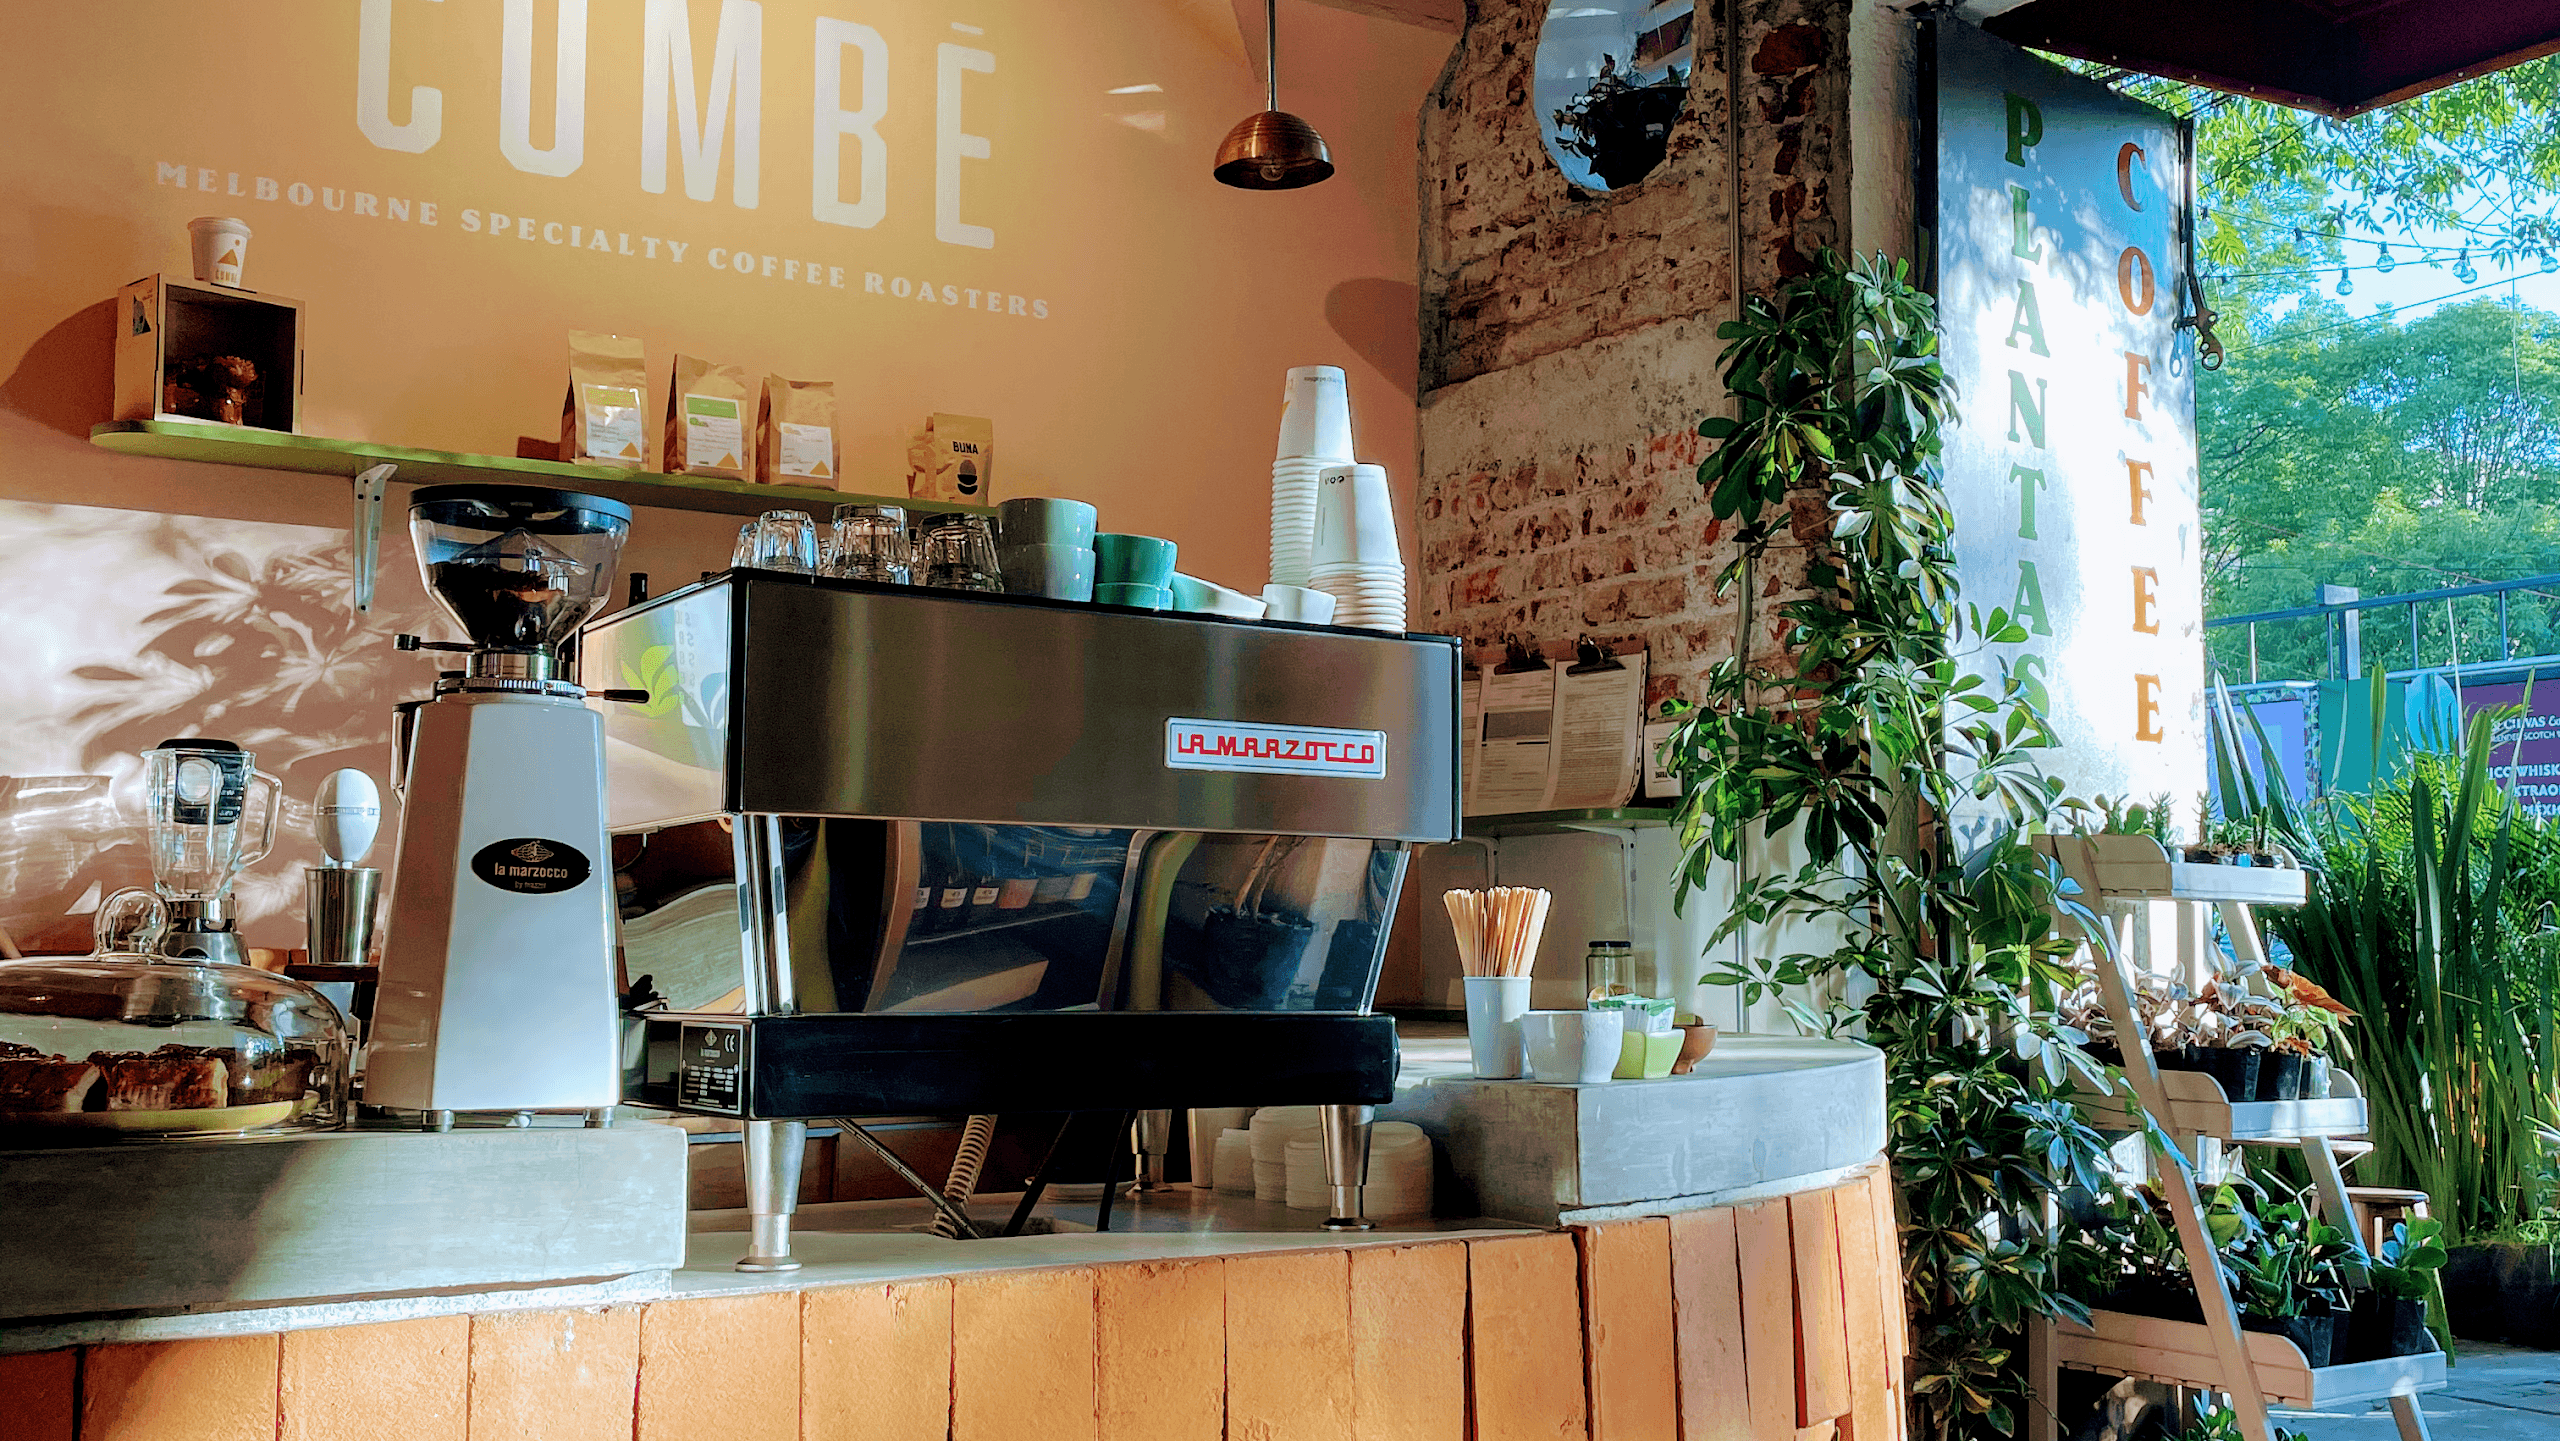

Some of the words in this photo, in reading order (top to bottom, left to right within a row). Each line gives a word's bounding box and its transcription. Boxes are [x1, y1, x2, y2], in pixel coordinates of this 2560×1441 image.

[156, 161, 439, 226] MELBOURNE
[460, 208, 690, 263] SPECIALTY
[707, 247, 845, 289] COFFEE
[864, 271, 1049, 320] ROASTERS
[952, 440, 979, 455] BUNA
[2004, 93, 2053, 719] PLANTAS
[2117, 142, 2164, 744] COFFEE
[2524, 730, 2556, 741] SCOTCH
[494, 862, 506, 876] la
[509, 866, 568, 878] marzocco
